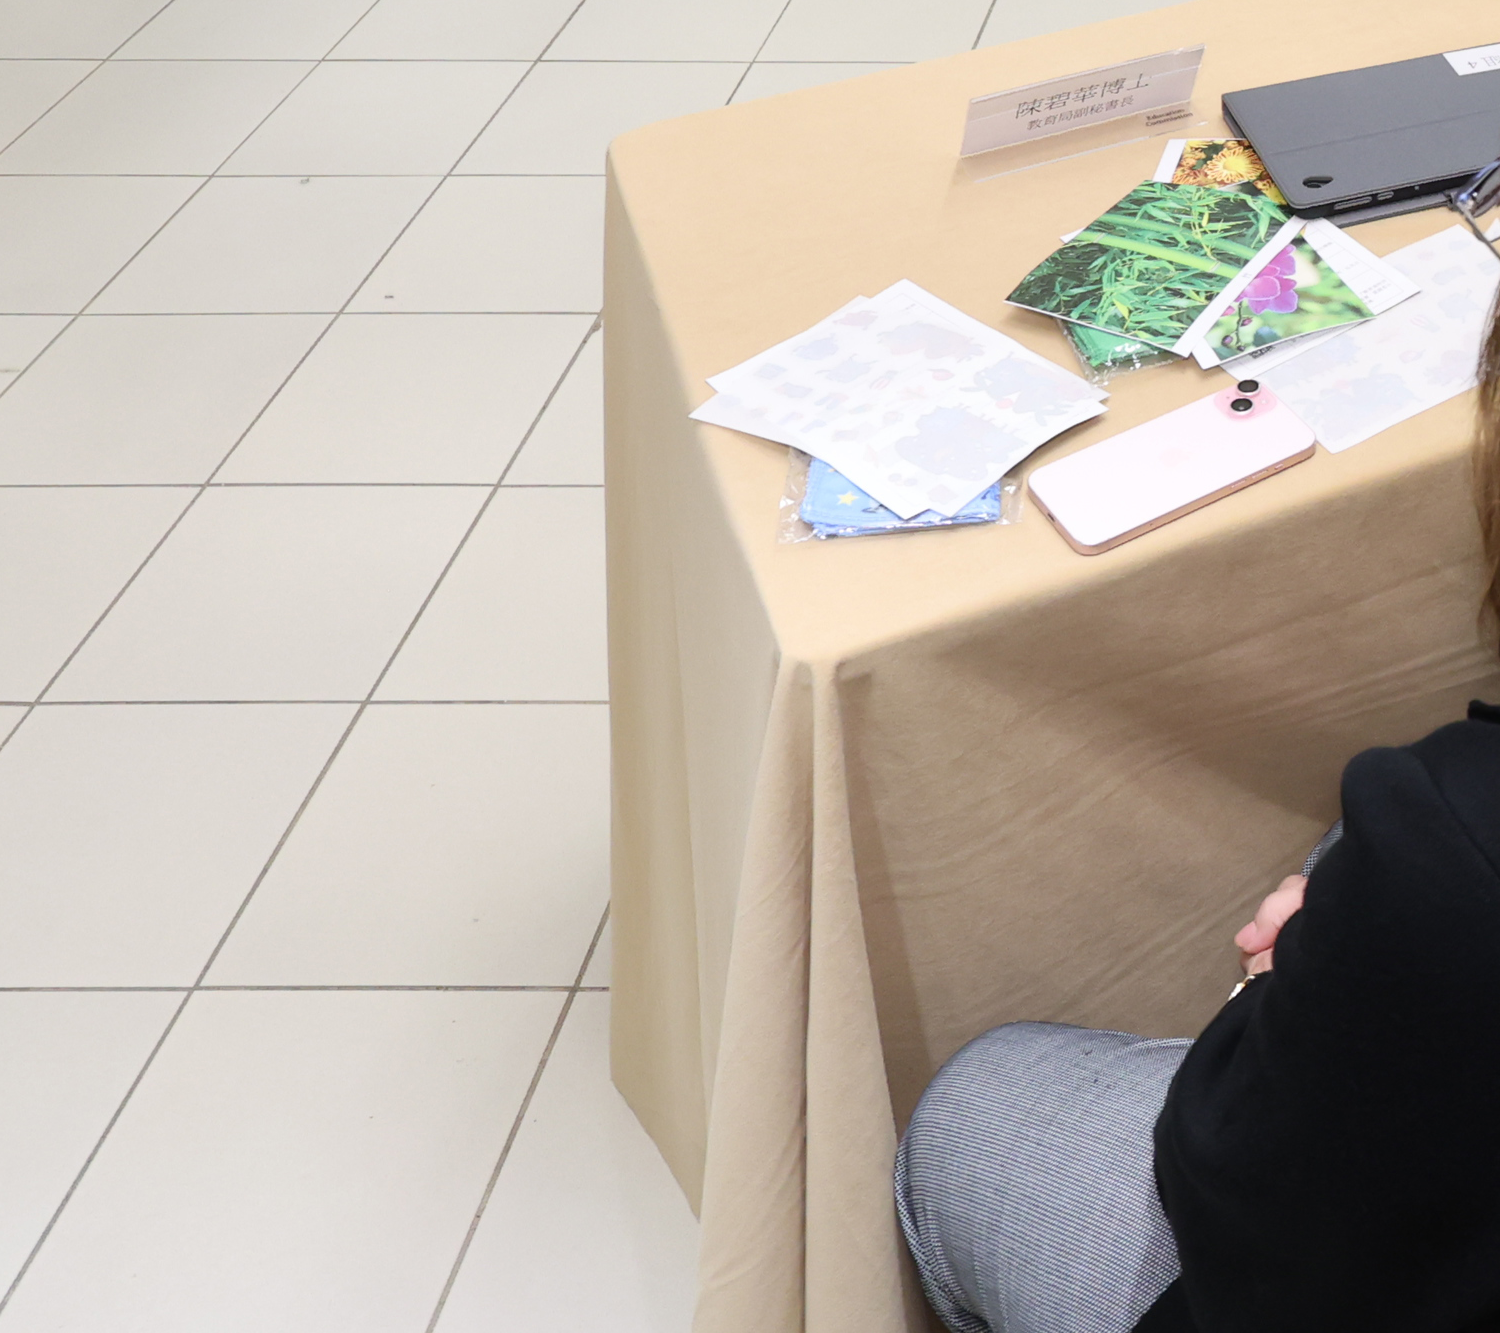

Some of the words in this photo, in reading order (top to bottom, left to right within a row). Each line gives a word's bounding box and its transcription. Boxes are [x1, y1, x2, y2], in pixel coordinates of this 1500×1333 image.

[1015, 73, 1149, 118] 陳碧華博士
[1026, 94, 1134, 131] 教育局副秘書長
